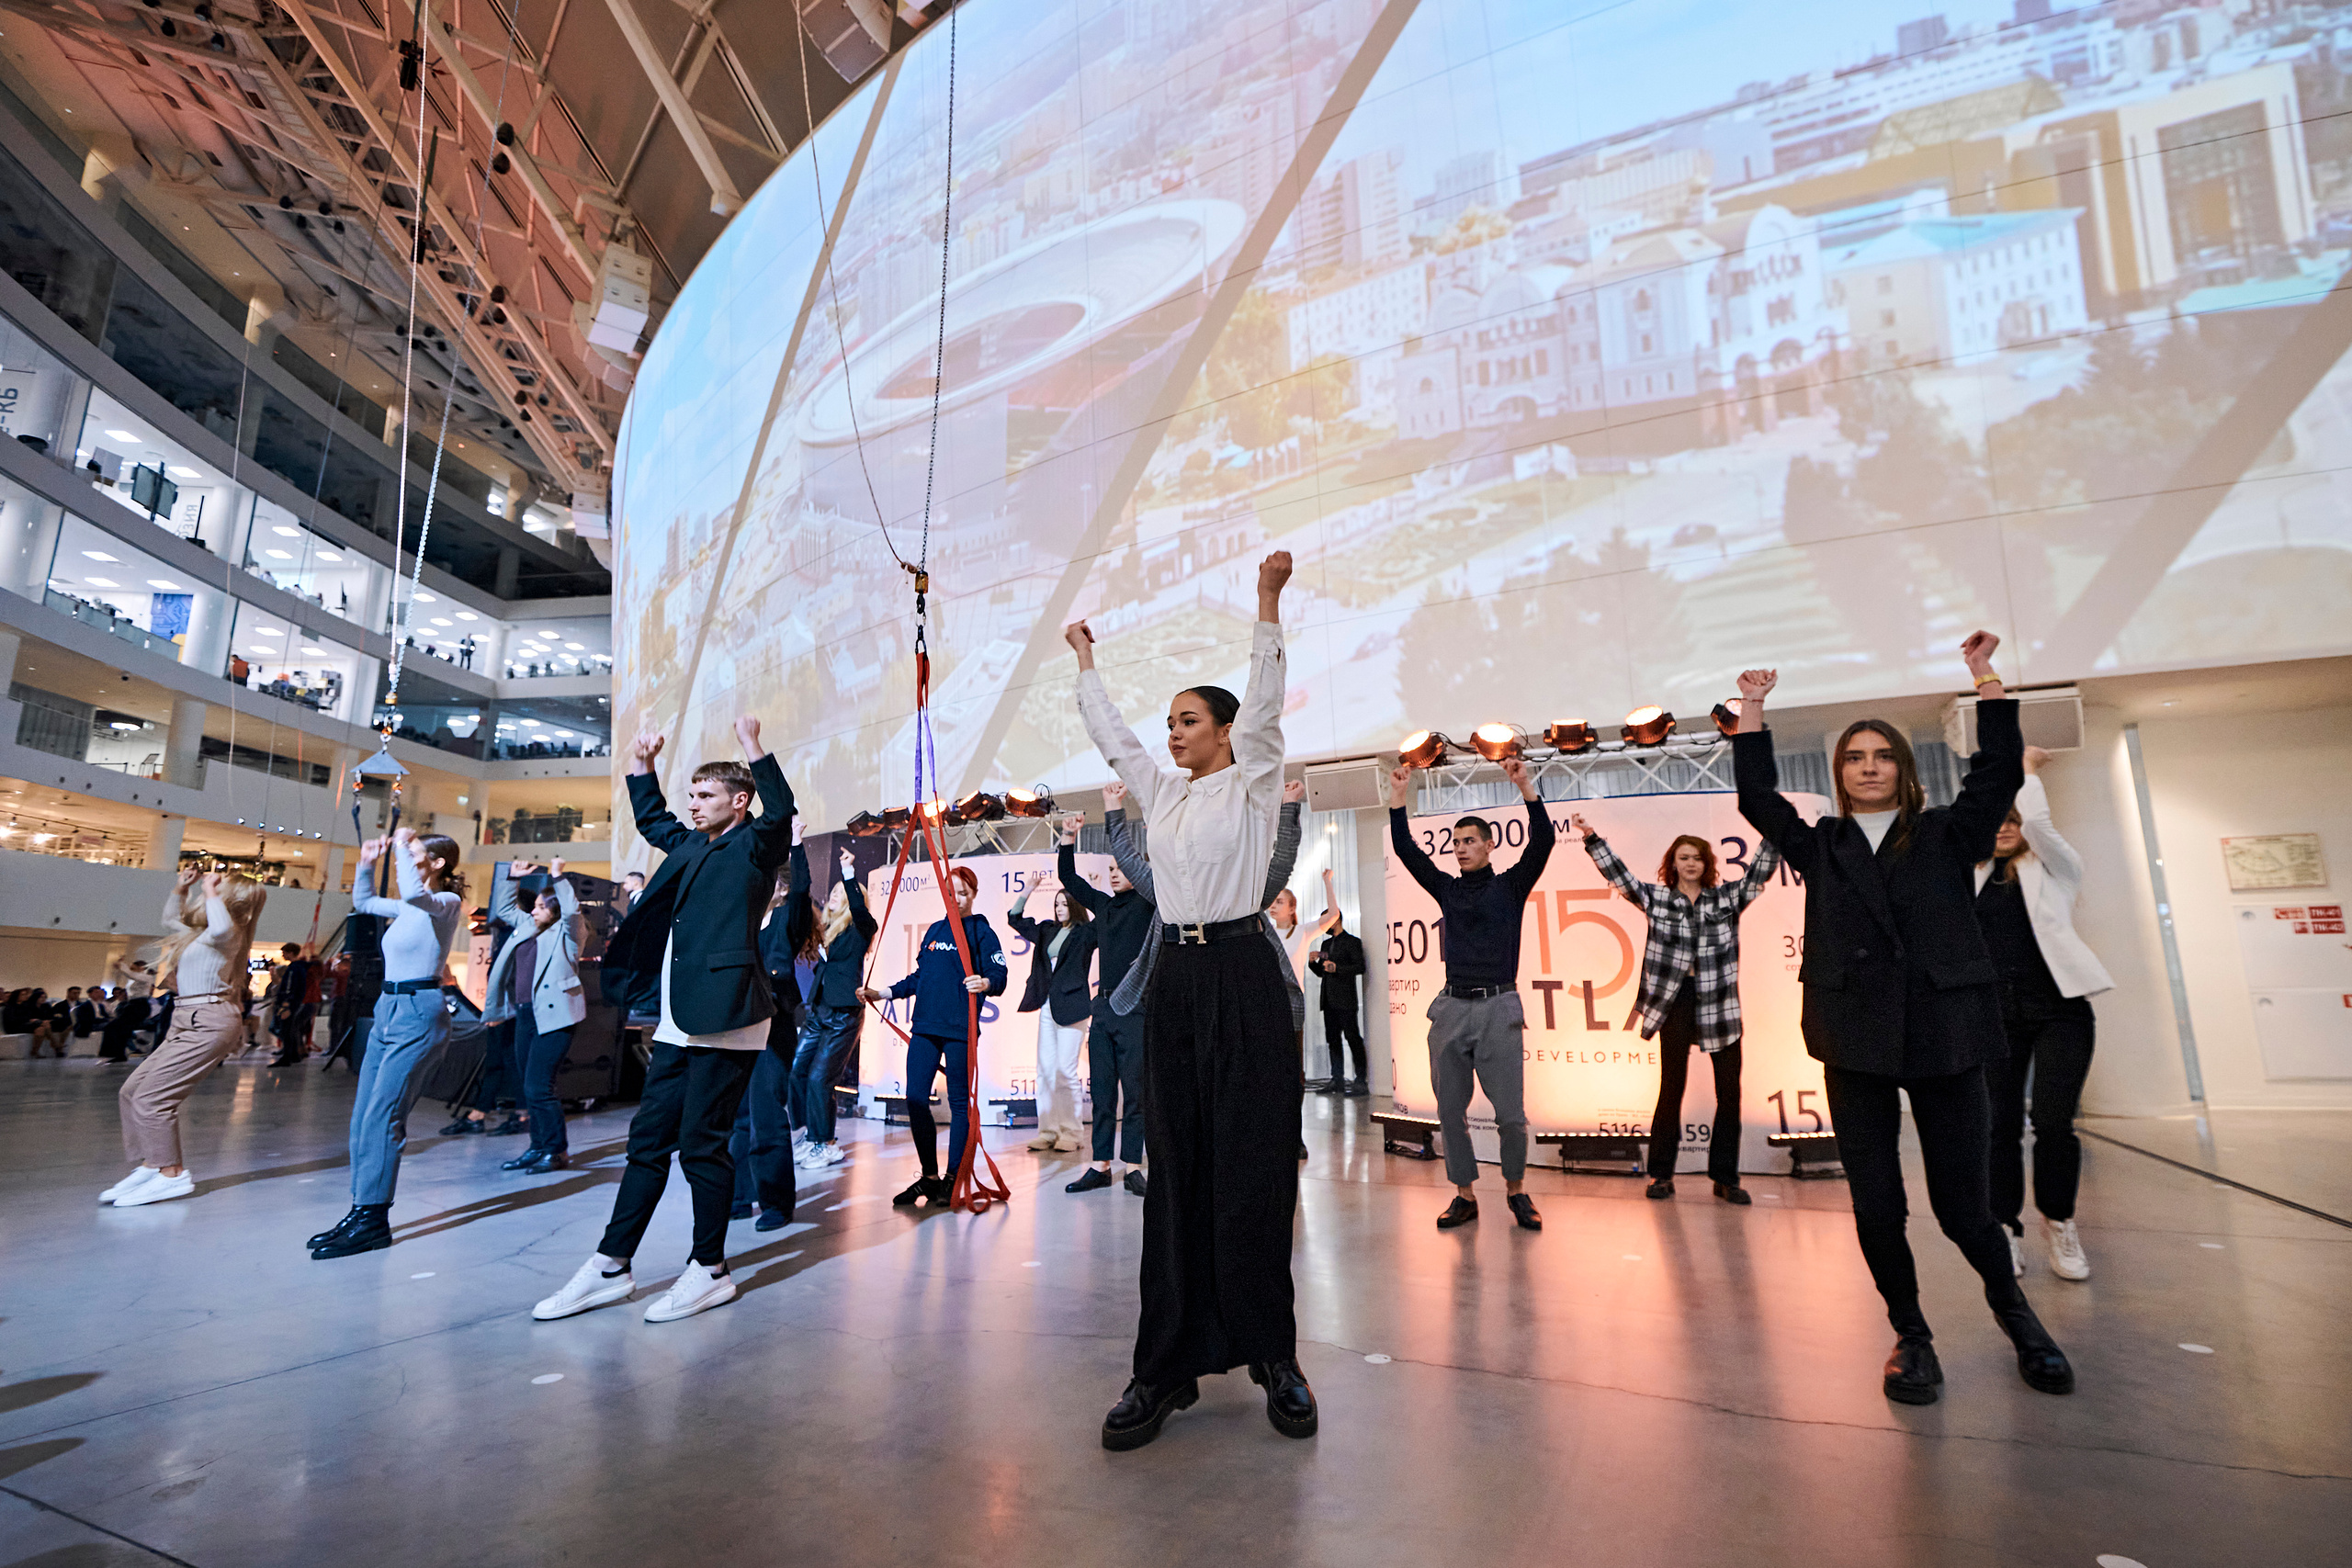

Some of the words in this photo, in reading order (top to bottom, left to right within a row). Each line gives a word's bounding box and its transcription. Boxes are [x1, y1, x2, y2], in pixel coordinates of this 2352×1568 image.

[1001, 872, 1025, 893] 15
[1527, 888, 1635, 999] 15
[1767, 1089, 1824, 1134] 15
